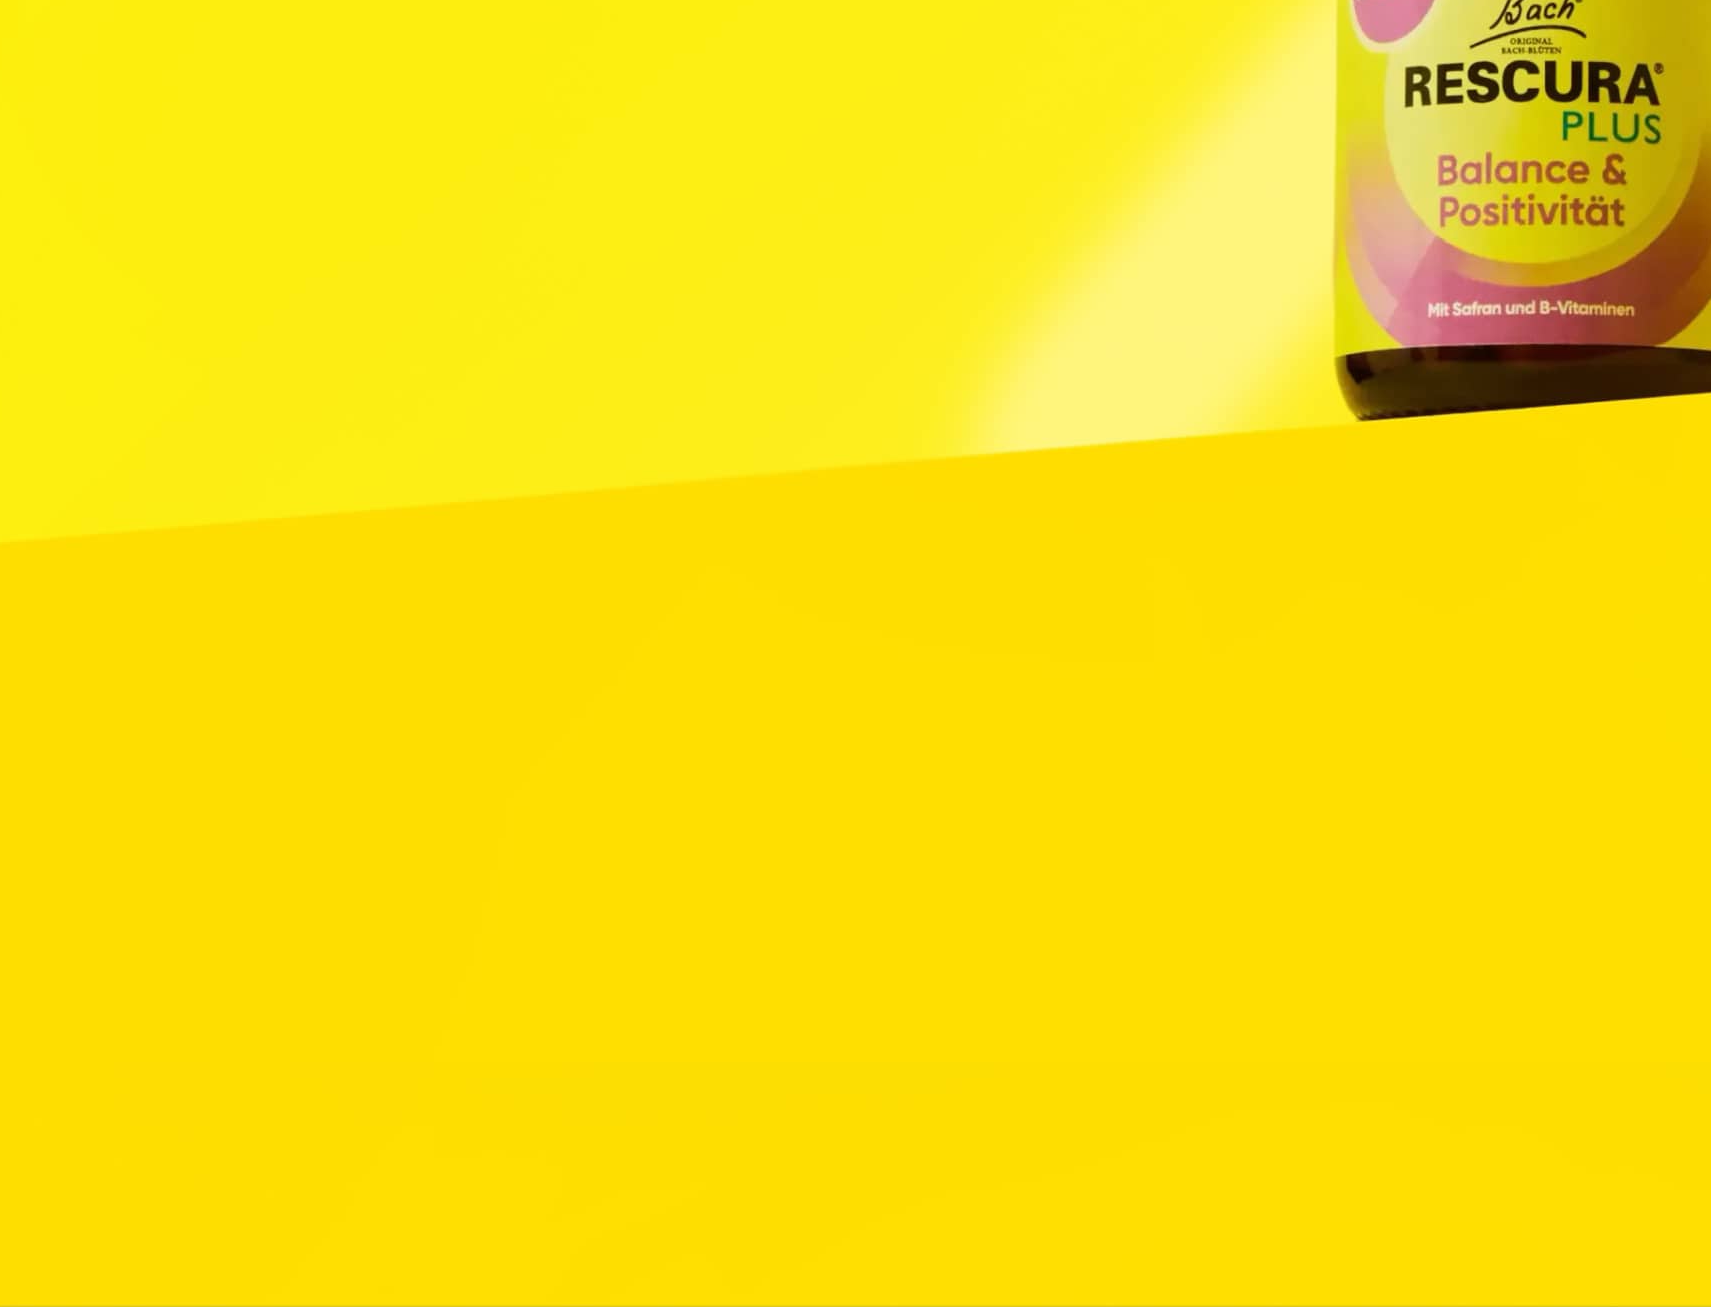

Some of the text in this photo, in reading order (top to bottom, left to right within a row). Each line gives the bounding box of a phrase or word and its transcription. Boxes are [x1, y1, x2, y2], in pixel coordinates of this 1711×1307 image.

[1501, 46, 1562, 55] BACH-BLÜTEN
[1509, 37, 1554, 45] ORIGINAL
[1562, 110, 1662, 144] PLUS
[1437, 152, 1627, 186] Balance &
[1439, 194, 1625, 227] Positivität
[1427, 300, 1635, 318] Mit Safran und B-Vitaminen
